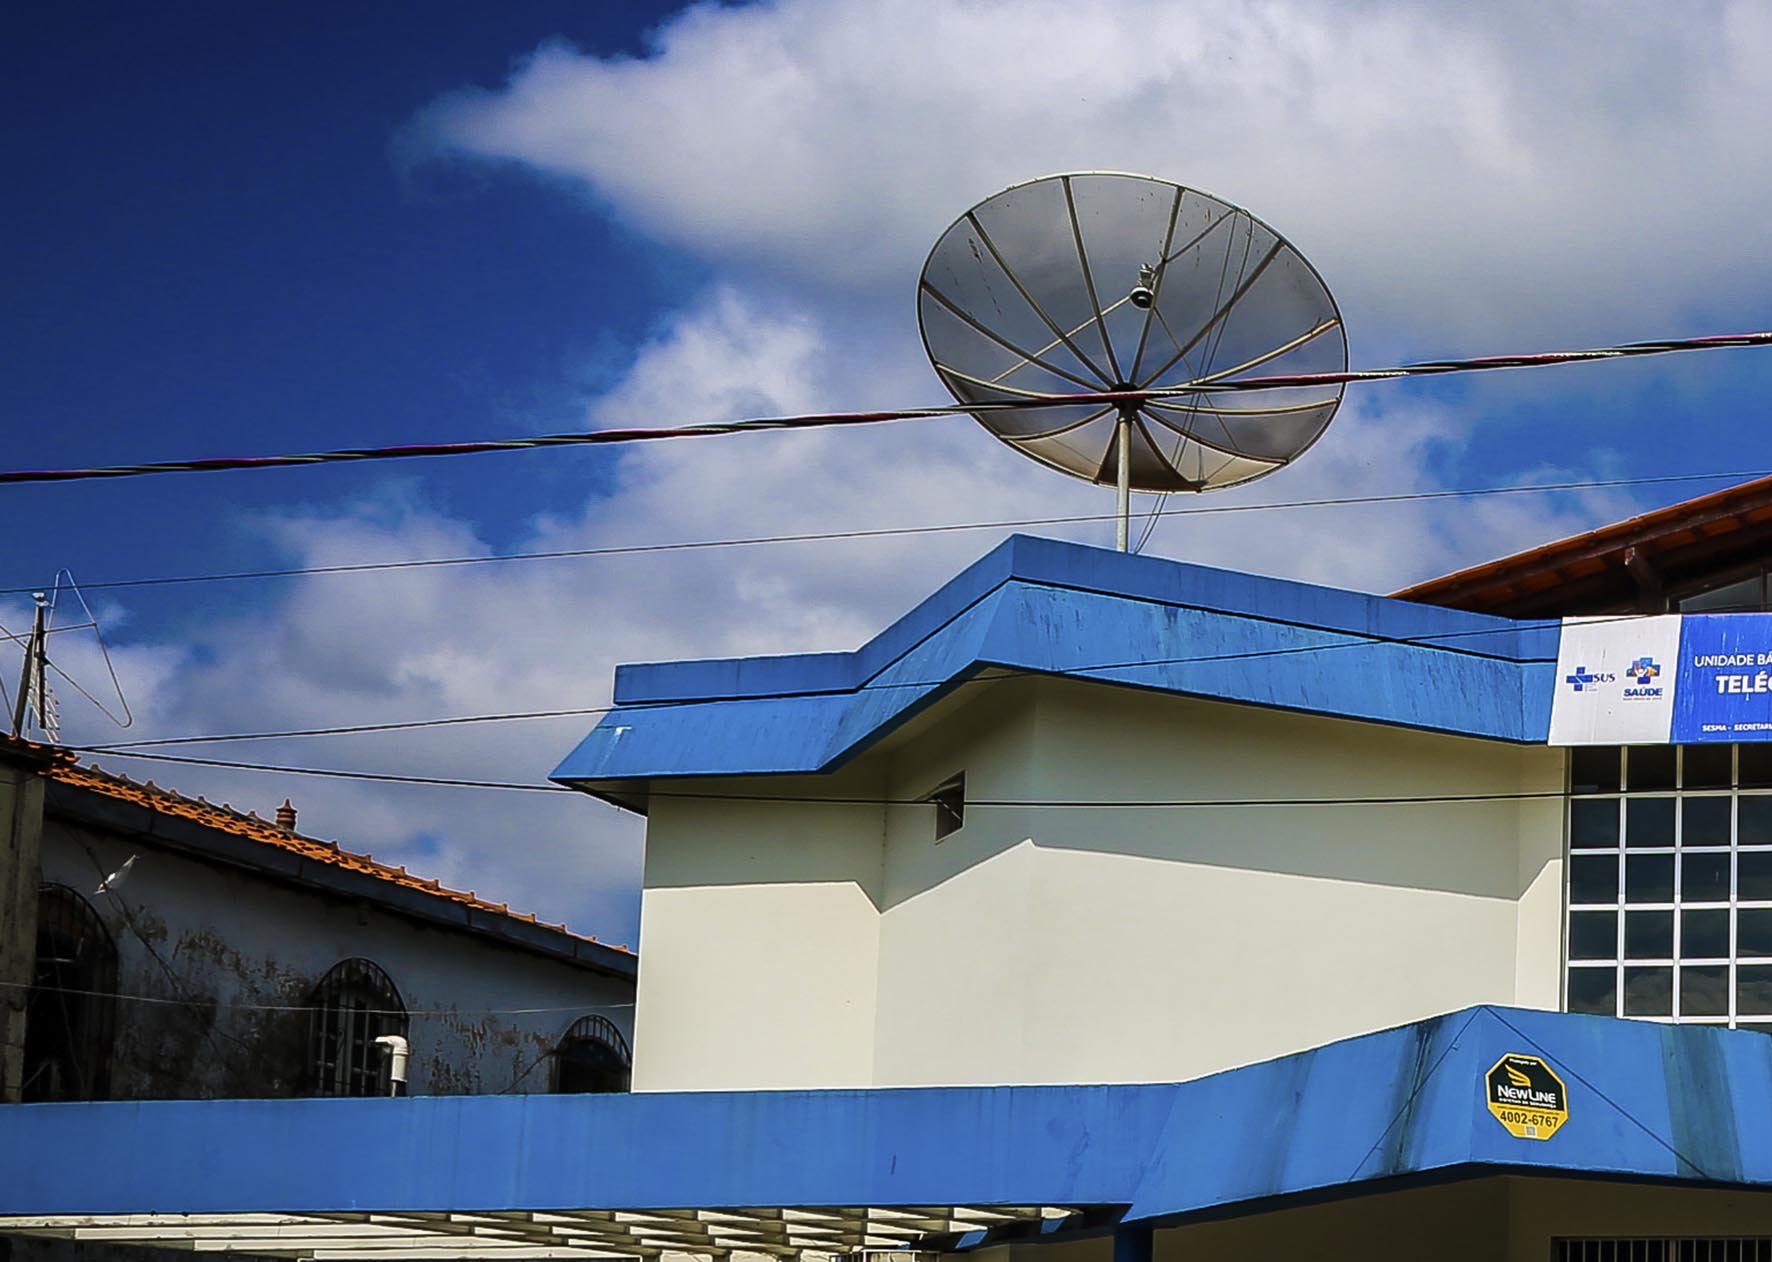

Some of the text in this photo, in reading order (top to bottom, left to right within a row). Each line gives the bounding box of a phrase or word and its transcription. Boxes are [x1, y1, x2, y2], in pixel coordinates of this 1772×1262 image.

[1695, 654, 1754, 667] UNIDADE
[1593, 673, 1616, 683] SUS
[1624, 686, 1663, 697] SAÚDE
[1500, 1111, 1559, 1128] 4002-6767
